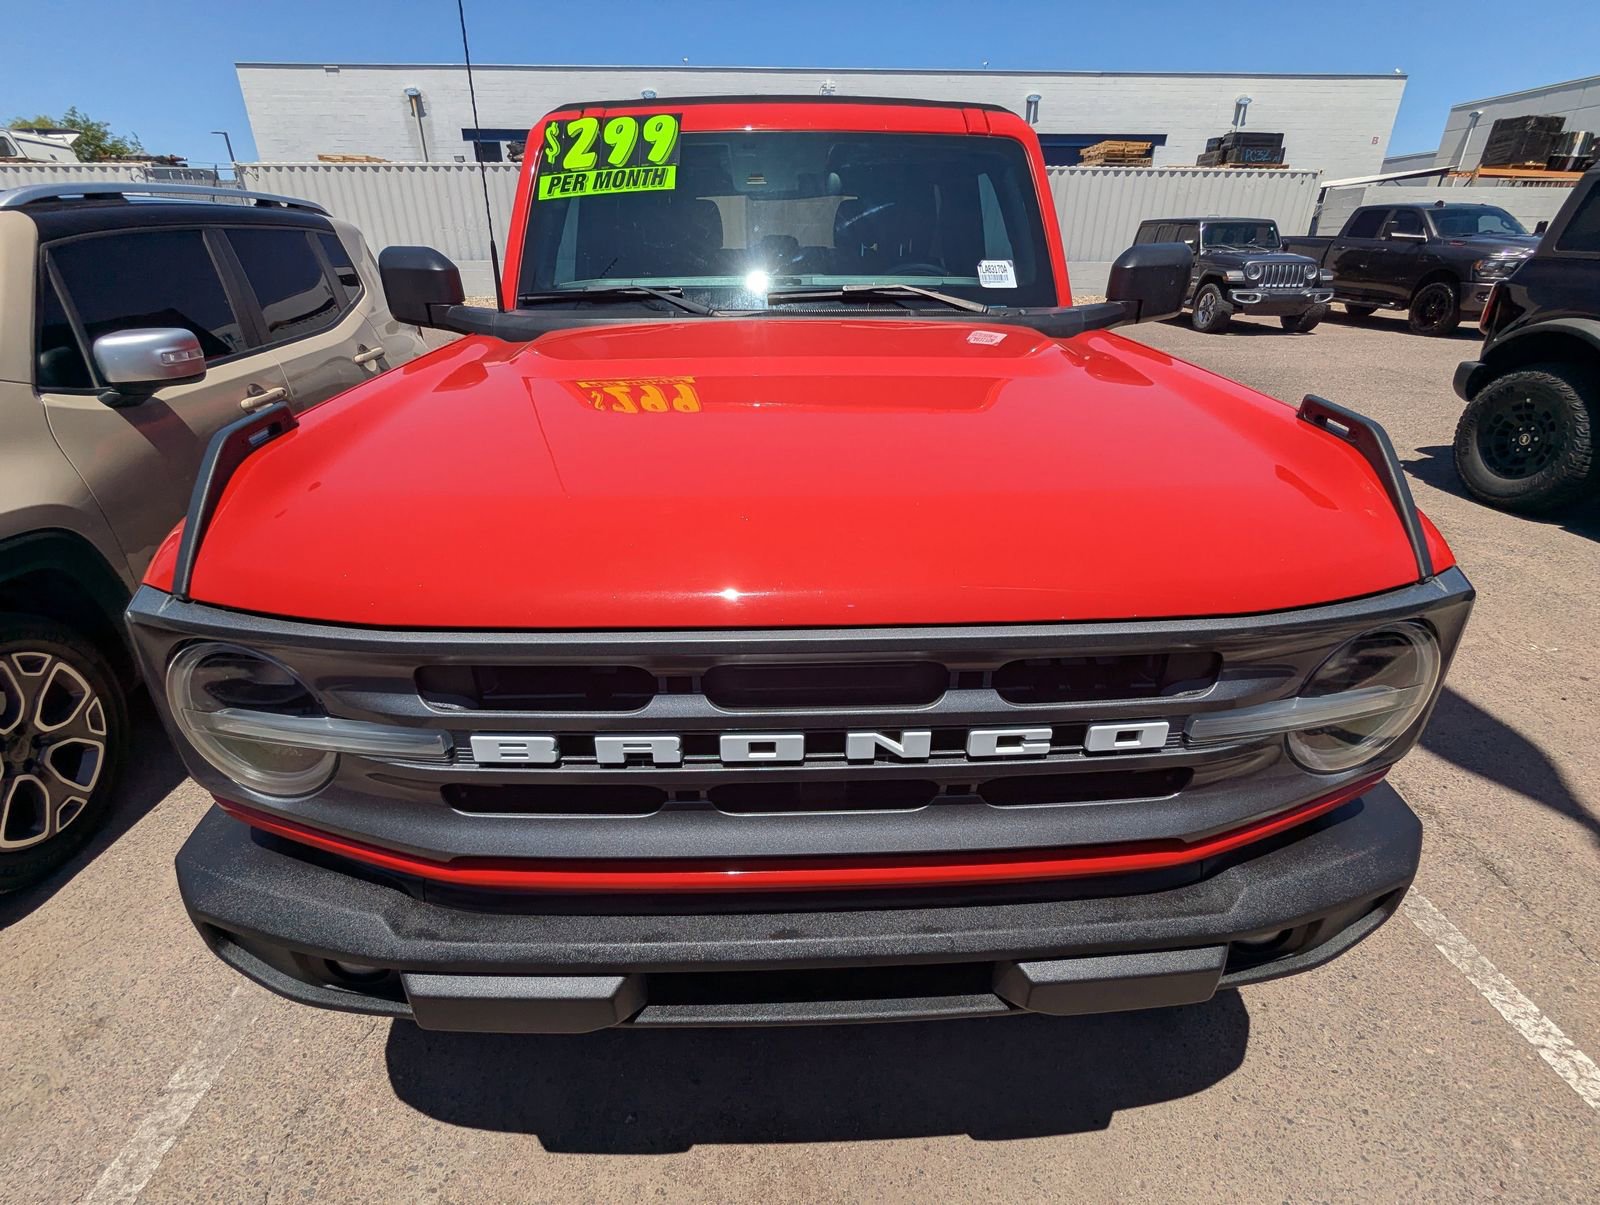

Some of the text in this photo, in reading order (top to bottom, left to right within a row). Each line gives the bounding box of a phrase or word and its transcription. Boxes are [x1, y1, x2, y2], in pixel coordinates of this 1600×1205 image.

[545, 114, 679, 171] $299
[547, 167, 668, 196] PER MONTH
[470, 720, 1170, 764] BRONCO
